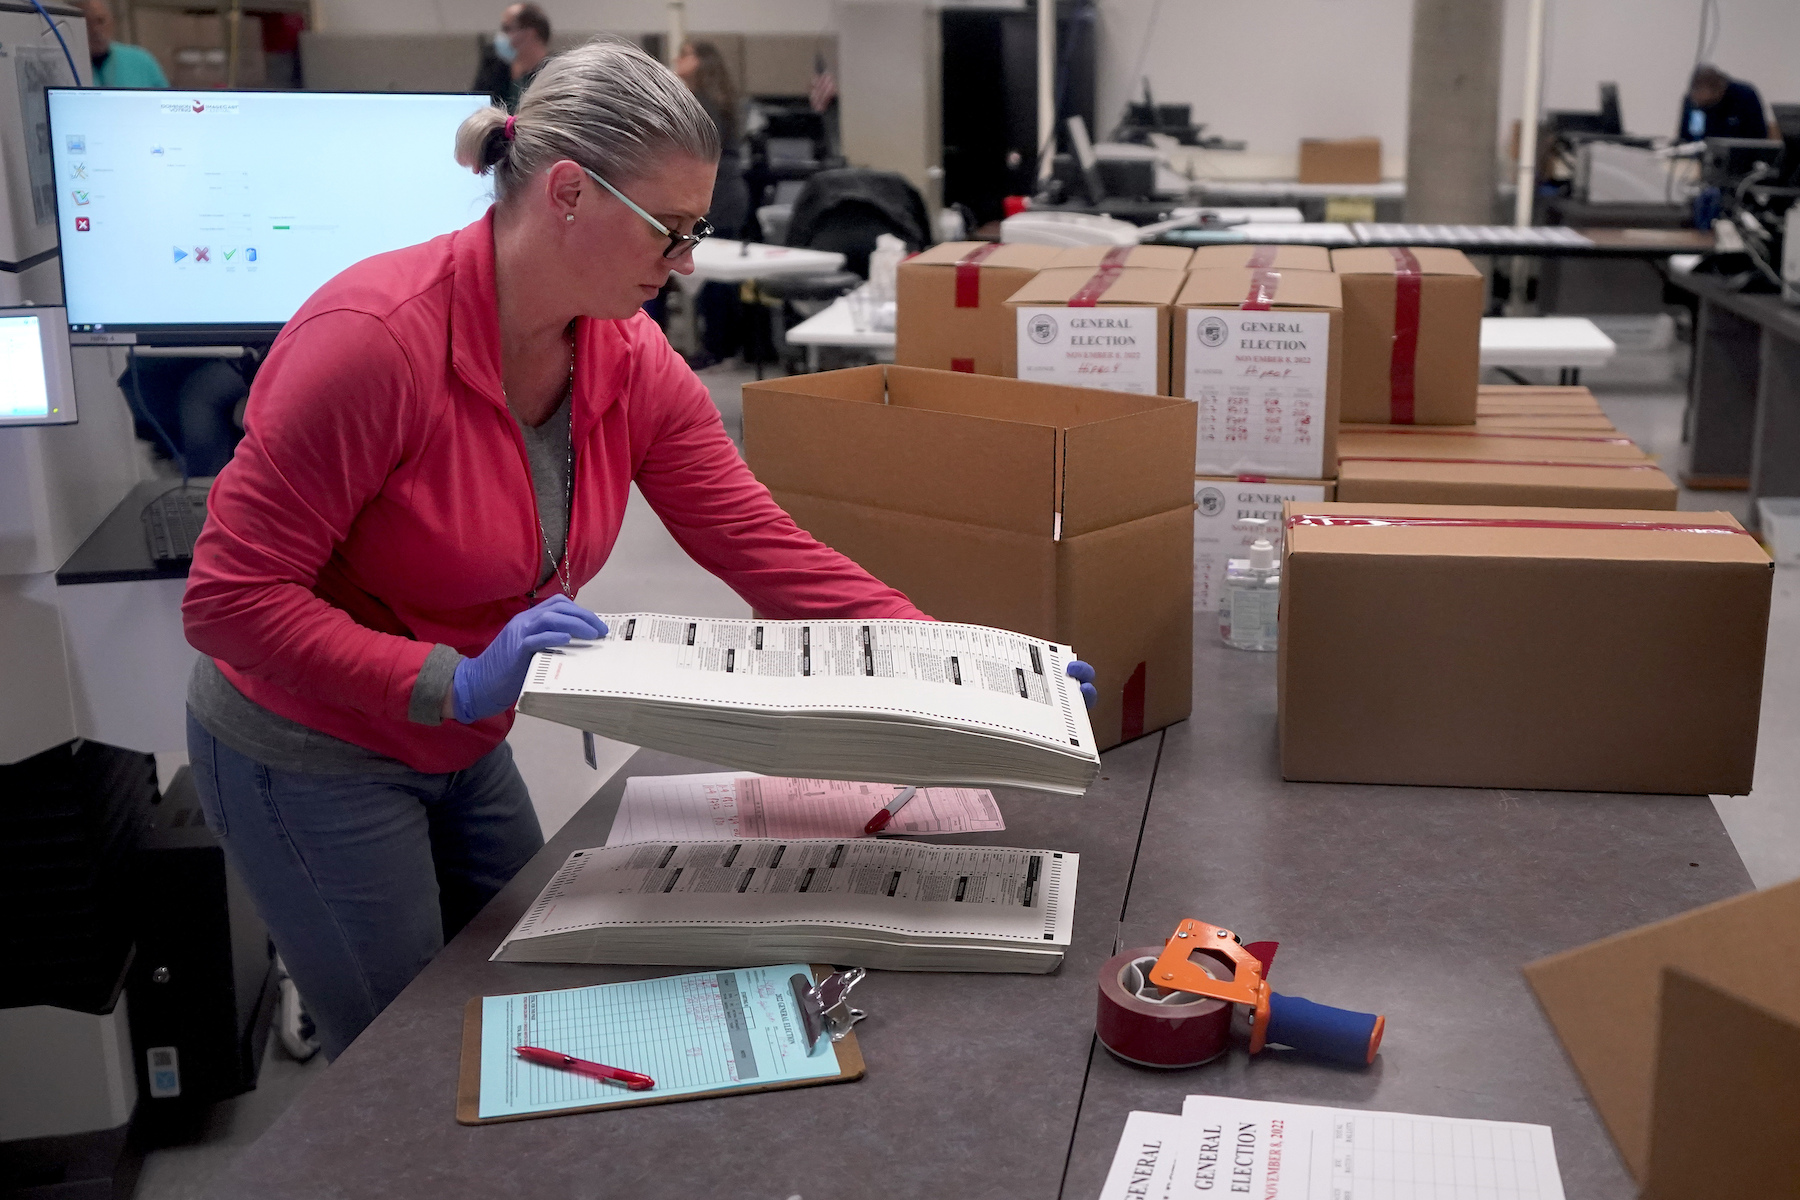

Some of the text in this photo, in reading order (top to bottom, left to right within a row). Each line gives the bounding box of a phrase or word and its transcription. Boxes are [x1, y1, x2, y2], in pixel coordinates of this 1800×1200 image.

[1070, 318, 1132, 329] GENERAL
[1241, 321, 1304, 333] GENERAL
[1070, 335, 1136, 346] ELECTION
[1240, 339, 1307, 350] ELECTION
[1065, 351, 1114, 359] NOVEMBER
[1235, 354, 1284, 363] NOVEMBER
[1294, 356, 1311, 364] 2022
[777, 1001, 790, 1023] GENERAL
[784, 1022, 796, 1045] ELECTION
[1270, 1119, 1284, 1139] 2022
[1194, 1124, 1222, 1191] GENERAL
[1230, 1121, 1257, 1194] ELECTION
